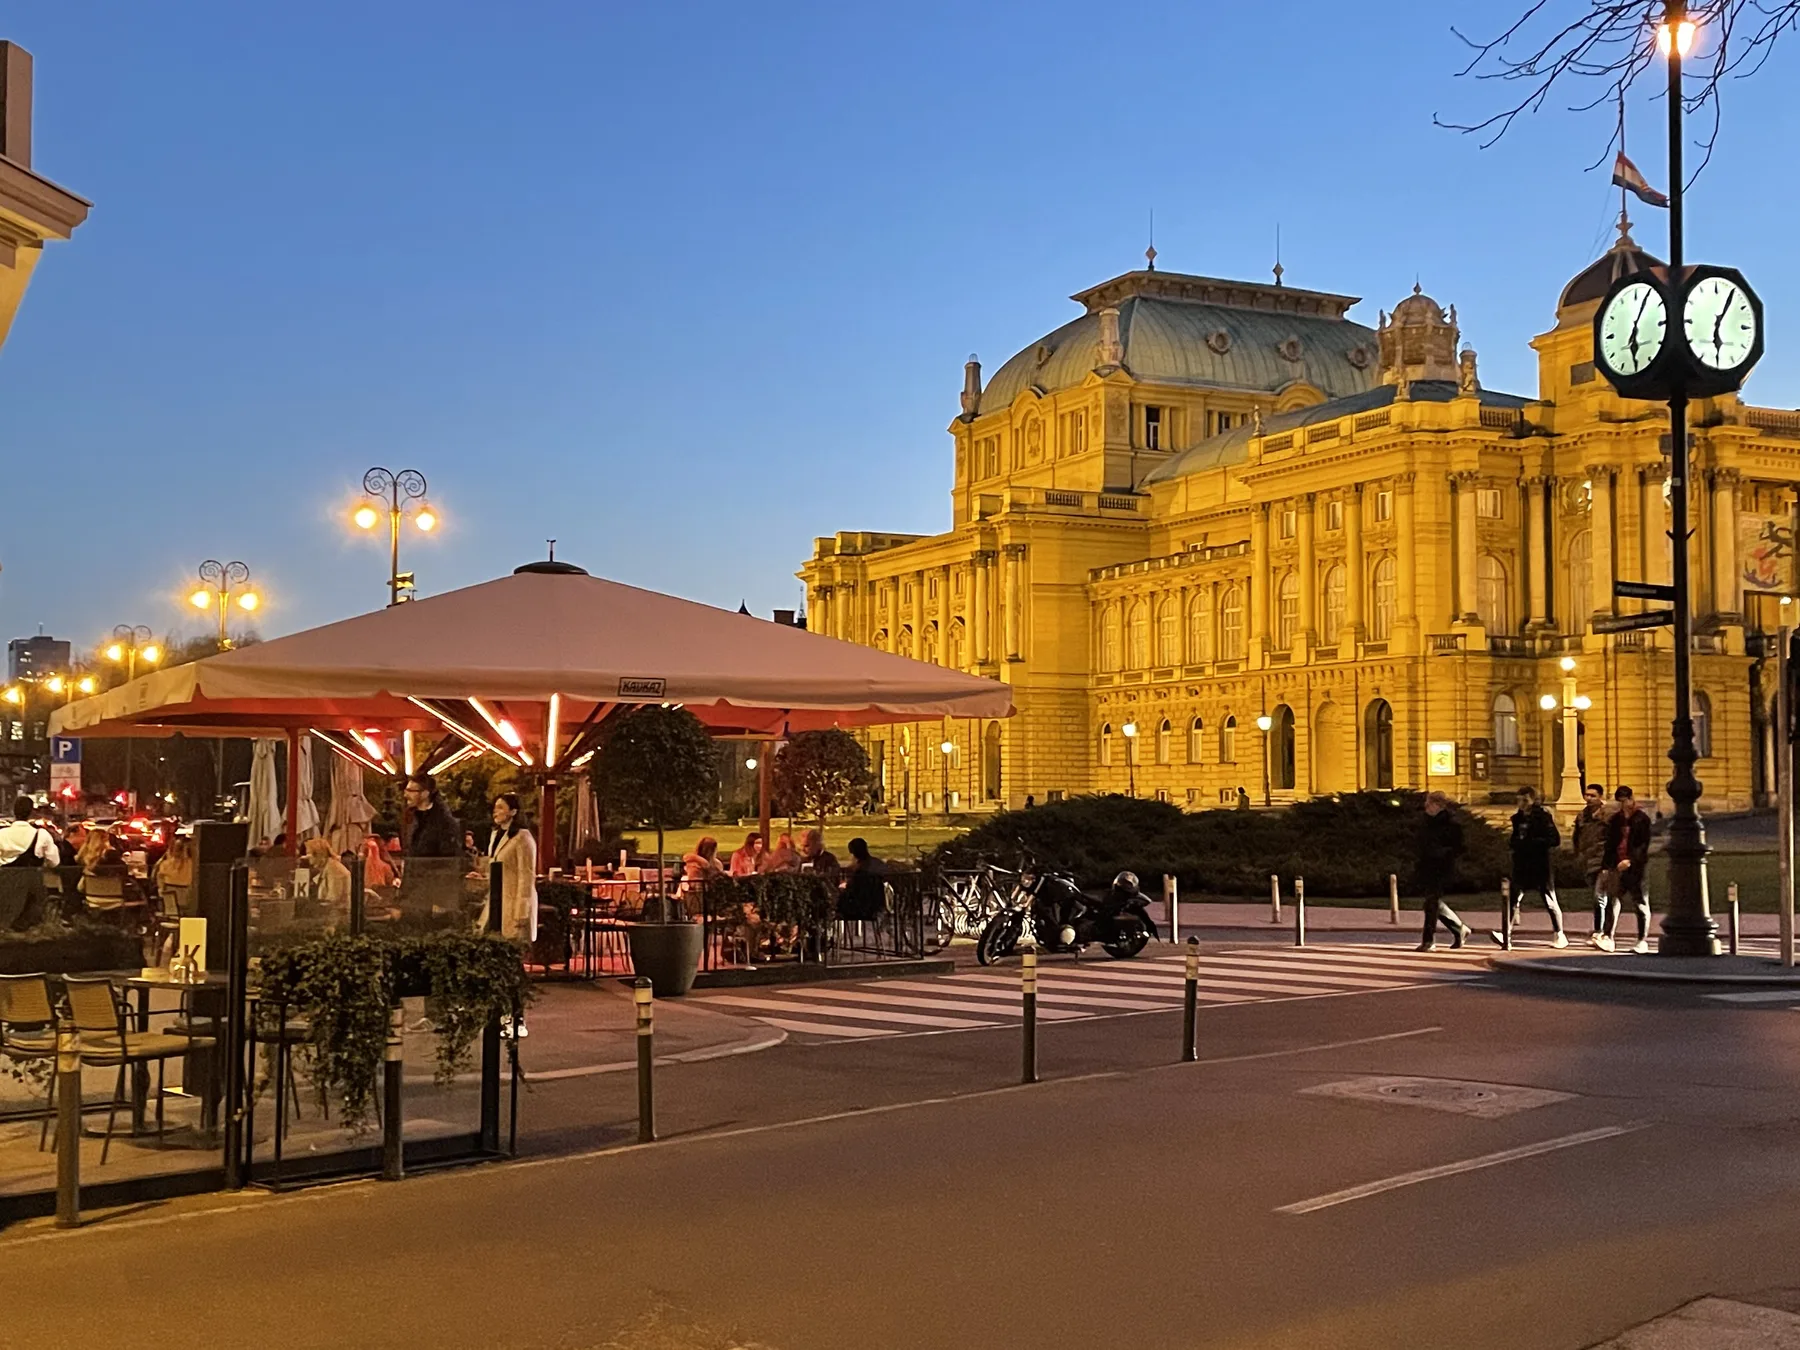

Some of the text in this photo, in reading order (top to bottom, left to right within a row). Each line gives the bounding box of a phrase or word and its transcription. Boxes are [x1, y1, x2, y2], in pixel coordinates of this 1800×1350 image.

[59, 740, 73, 759] P
[297, 881, 307, 898] K
[184, 944, 201, 973] K
